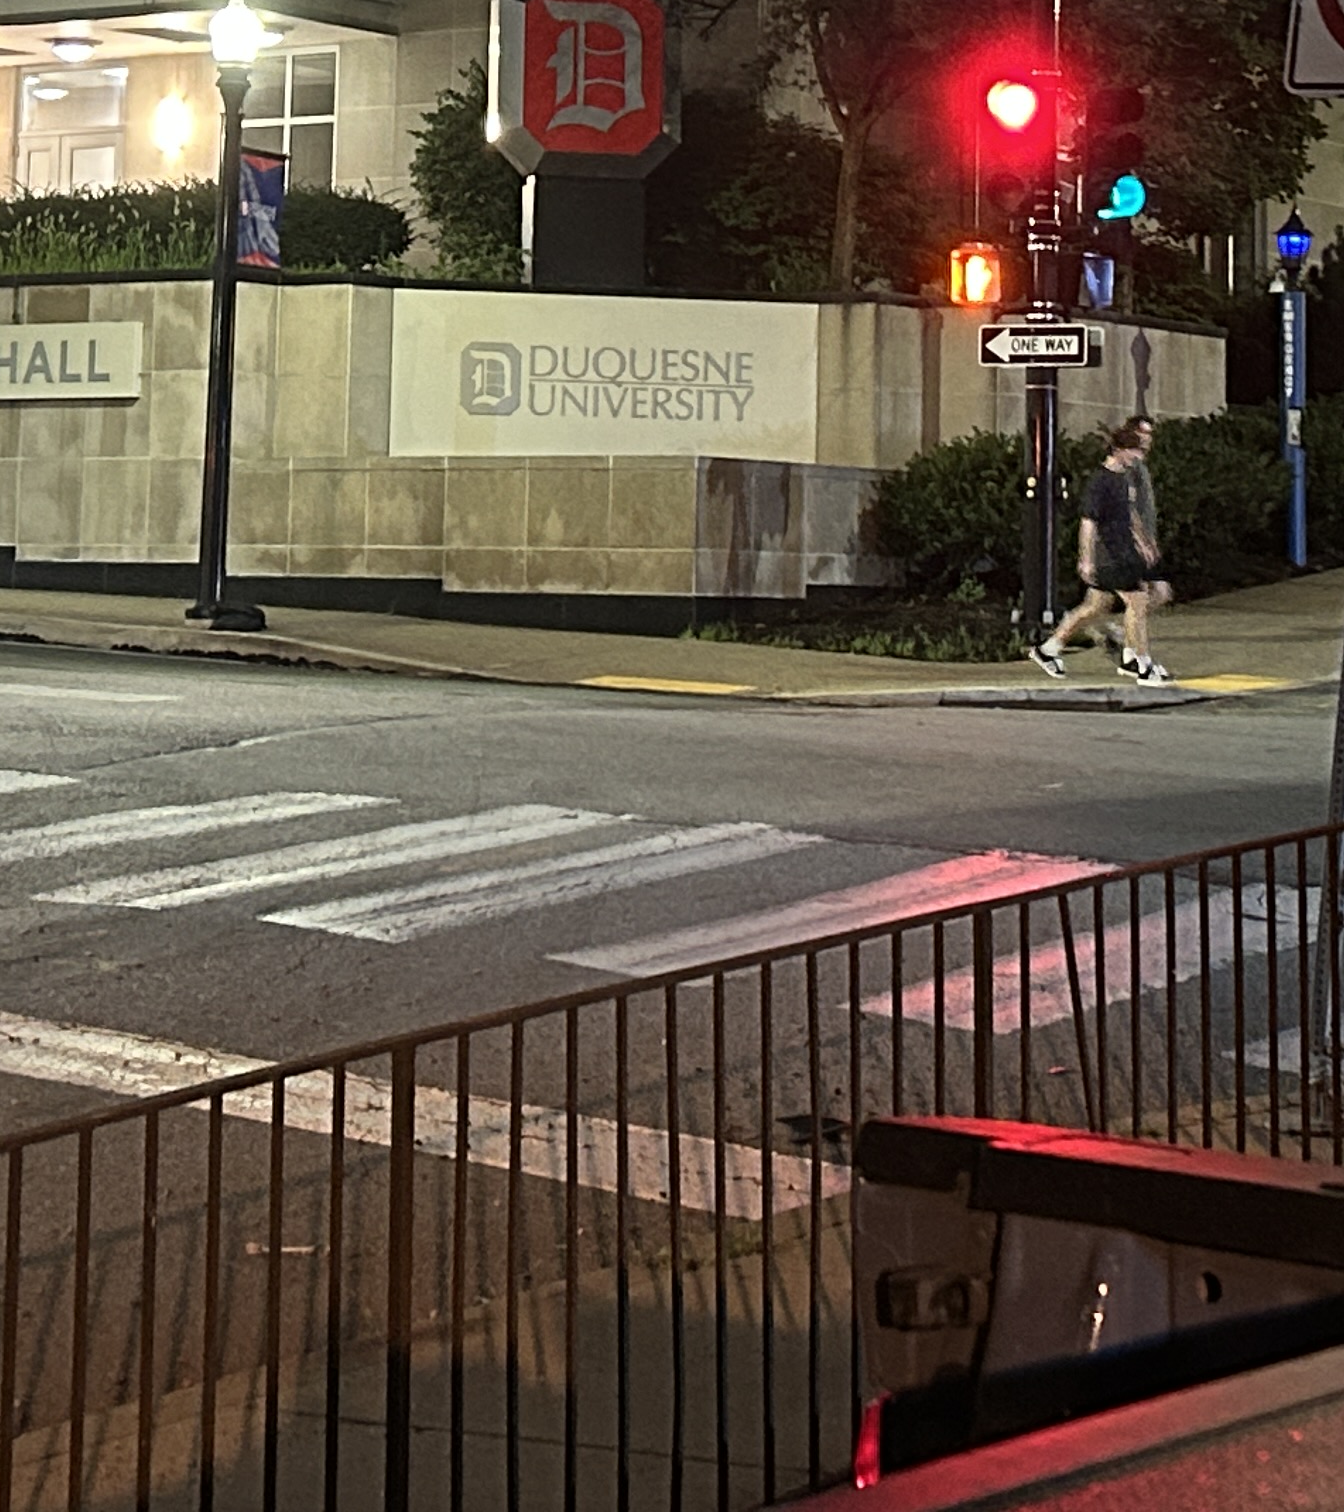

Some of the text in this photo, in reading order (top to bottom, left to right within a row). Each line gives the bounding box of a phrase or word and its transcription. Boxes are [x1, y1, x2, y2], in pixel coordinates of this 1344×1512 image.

[529, 344, 755, 387] DUQUESNE
[1010, 337, 1074, 354] ONE WAY
[1282, 299, 1295, 397] EMERGENCY
[528, 382, 756, 422] UNIVERSITY
